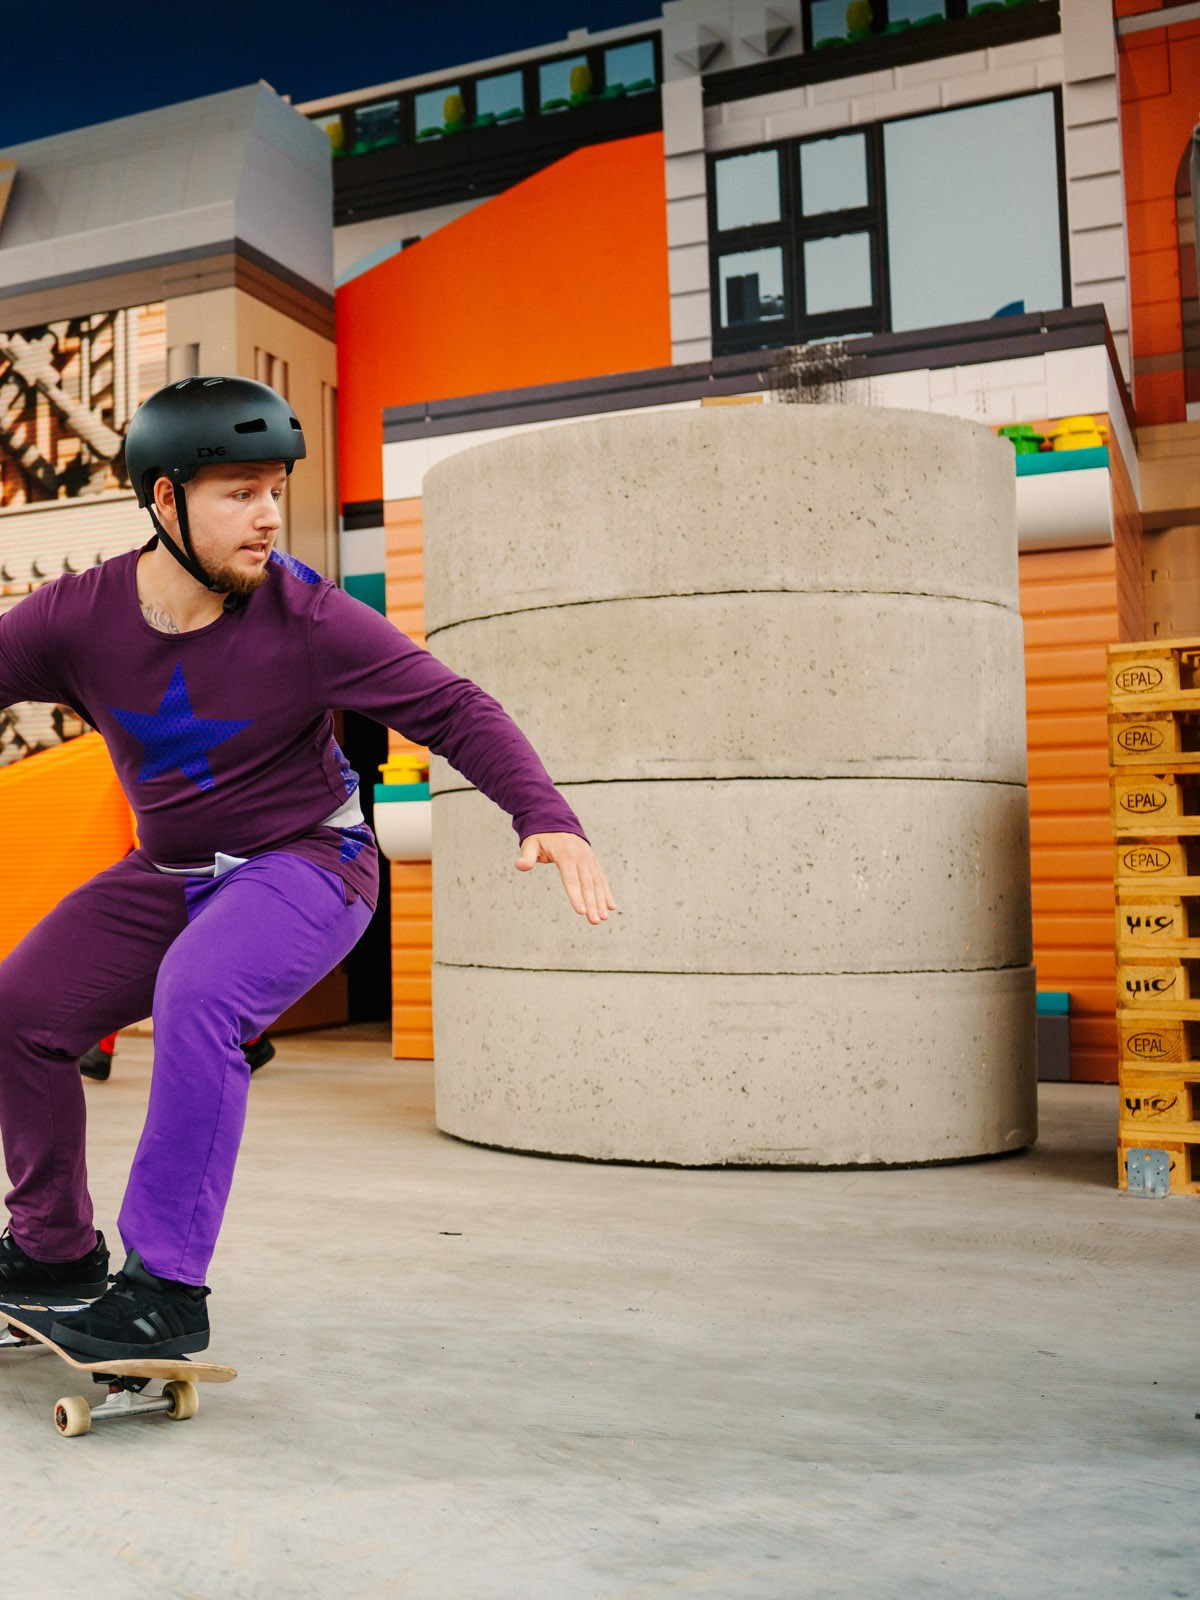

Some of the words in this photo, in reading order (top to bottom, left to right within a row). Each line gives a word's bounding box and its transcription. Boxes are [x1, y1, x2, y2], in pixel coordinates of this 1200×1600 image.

[1122, 671, 1156, 688] EPAL
[1125, 731, 1156, 746] EPAL
[1127, 793, 1160, 808] EPAL
[1130, 852, 1163, 868] EPAL
[1134, 1037, 1167, 1052] EPAL
